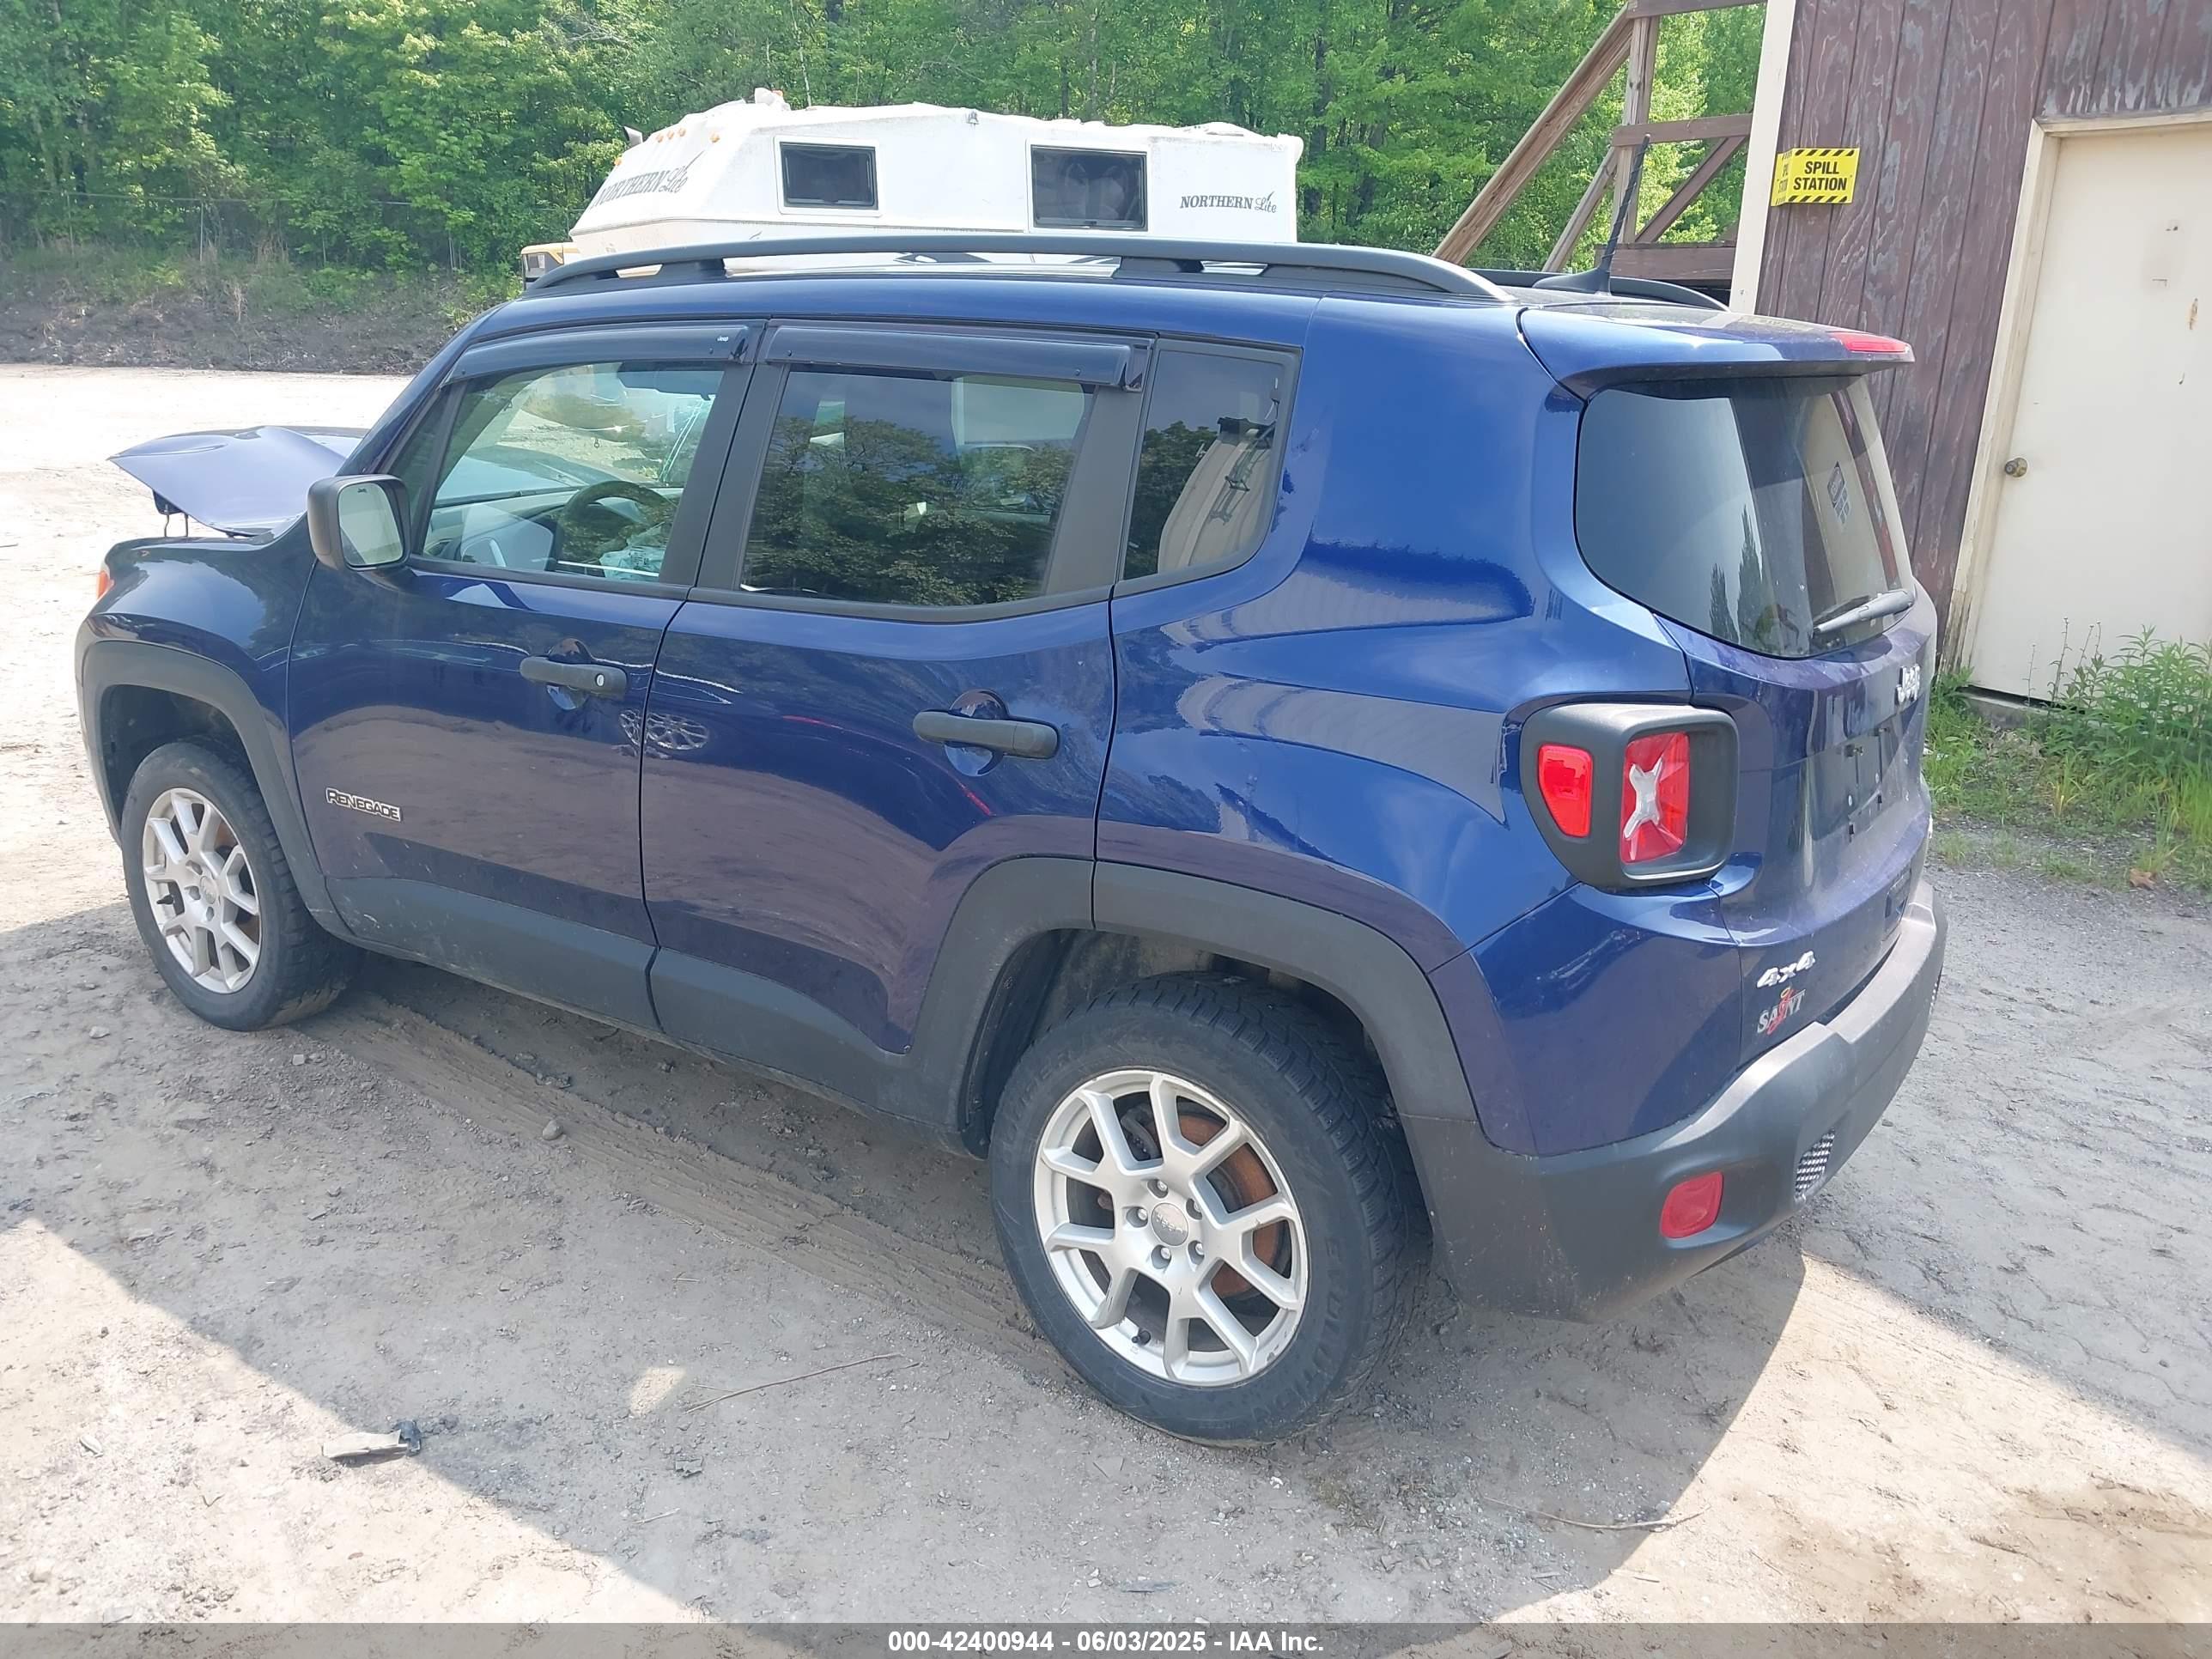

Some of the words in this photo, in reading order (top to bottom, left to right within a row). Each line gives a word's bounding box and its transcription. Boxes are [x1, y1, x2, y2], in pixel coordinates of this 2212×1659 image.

[1804, 161, 1839, 174] SPILL
[589, 170, 671, 210] NORTHERN
[1793, 177, 1847, 191] STATION
[1180, 195, 1255, 210] NORTHERN
[1254, 191, 1277, 213] Lite
[326, 787, 401, 822] RENEGADE
[1757, 951, 1816, 988] 4x4
